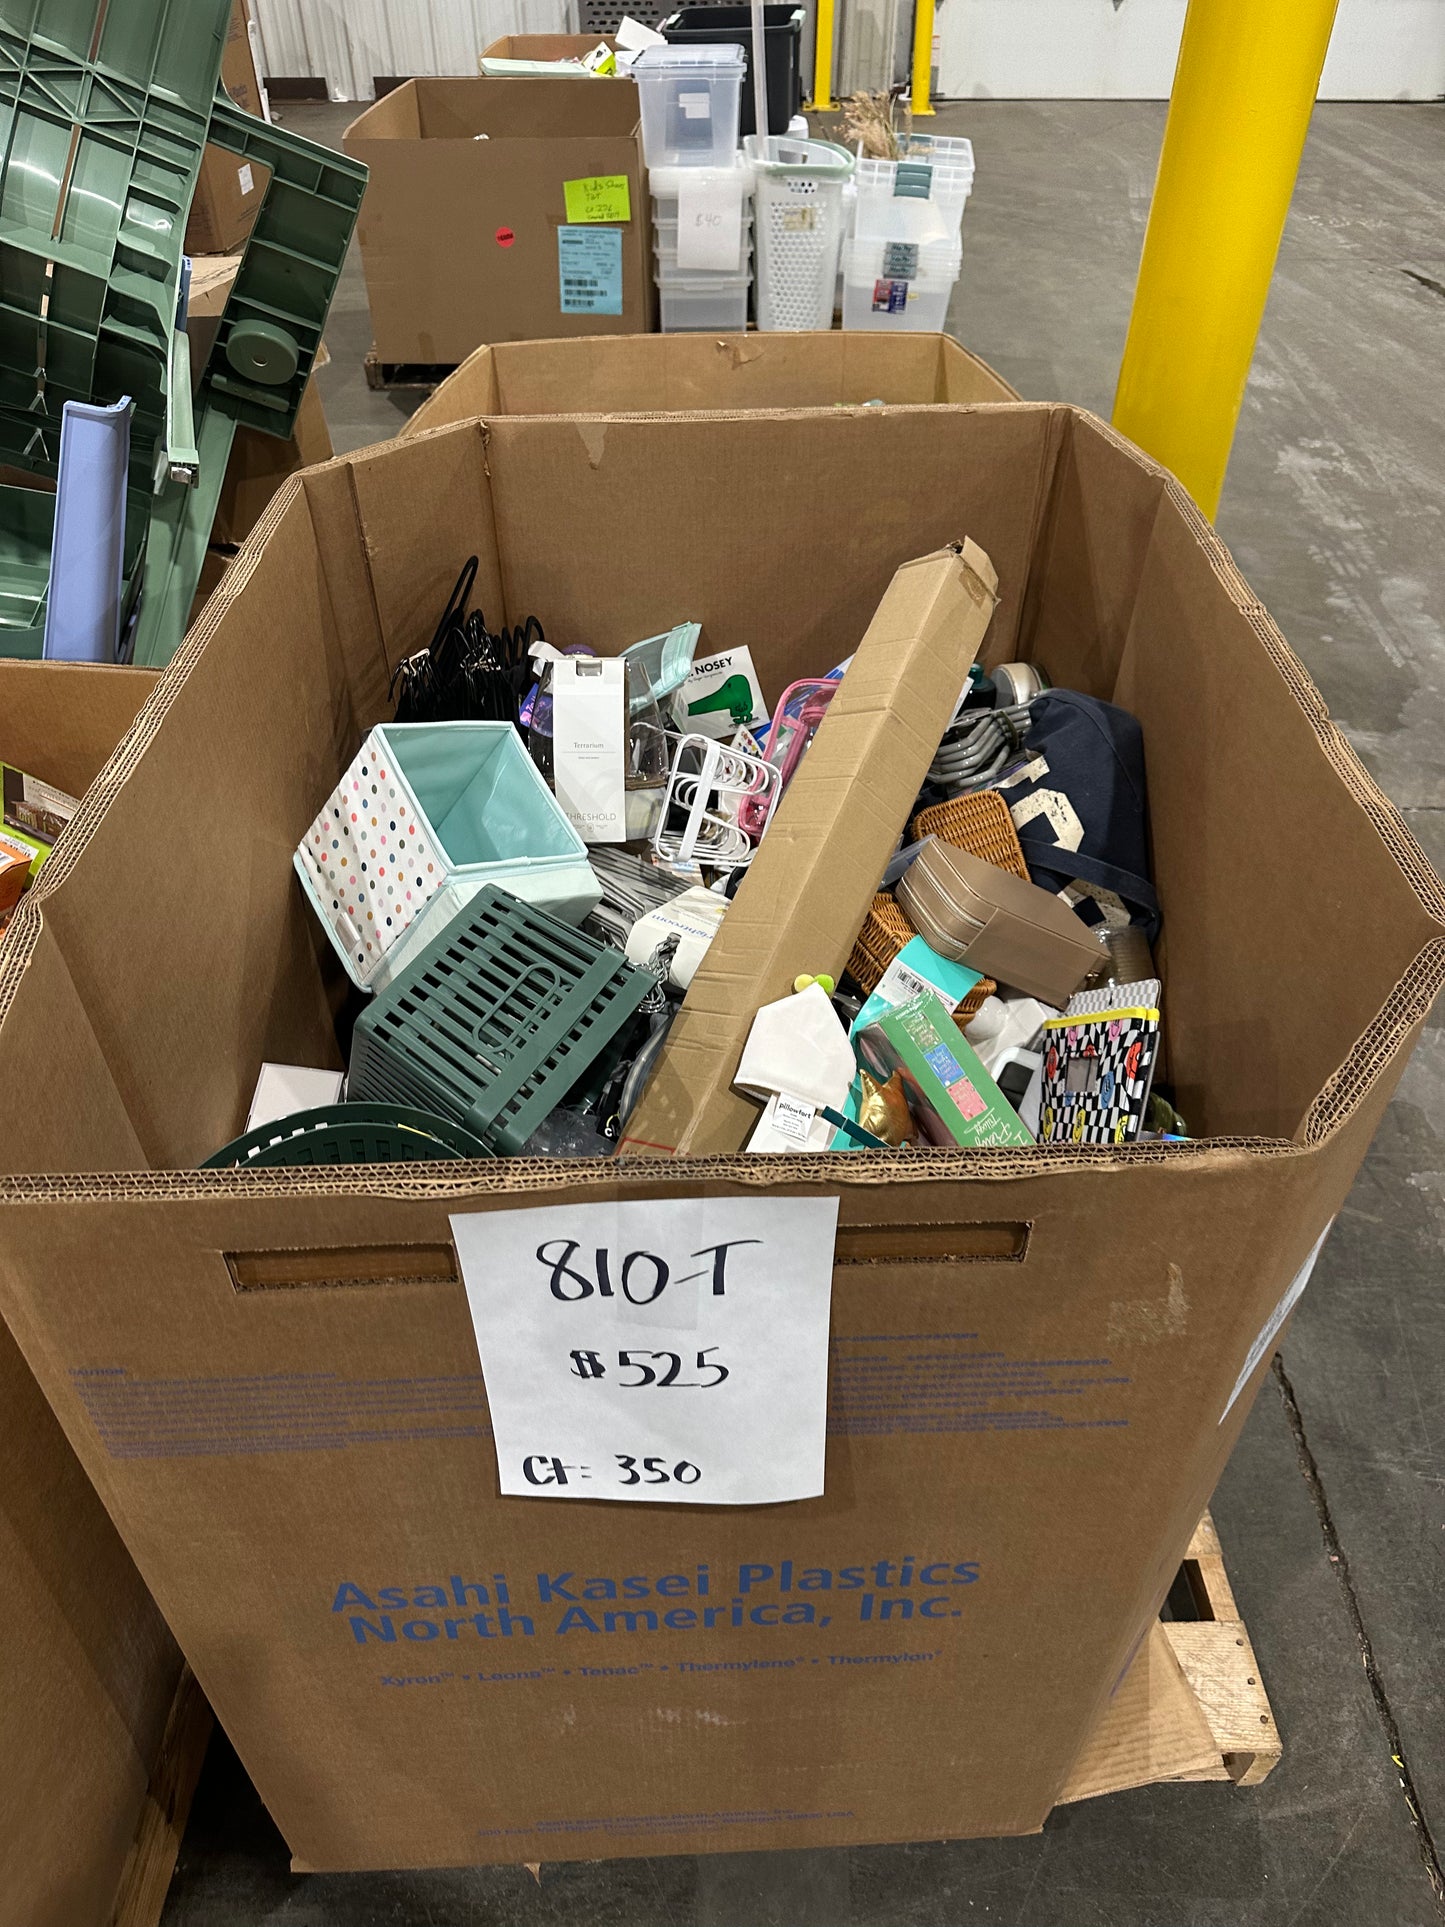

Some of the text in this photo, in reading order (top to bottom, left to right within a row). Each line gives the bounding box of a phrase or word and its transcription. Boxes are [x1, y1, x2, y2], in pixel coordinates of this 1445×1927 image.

[694, 656, 732, 675] NOSEY
[778, 1102, 812, 1120] pillowfort
[535, 1238, 764, 1306] 810-T
[569, 1346, 730, 1388] $525
[614, 1454, 702, 1485] 350
[331, 1556, 981, 1613] Asahi Kasei Plastics
[349, 1593, 962, 1645] North America, Inc.
